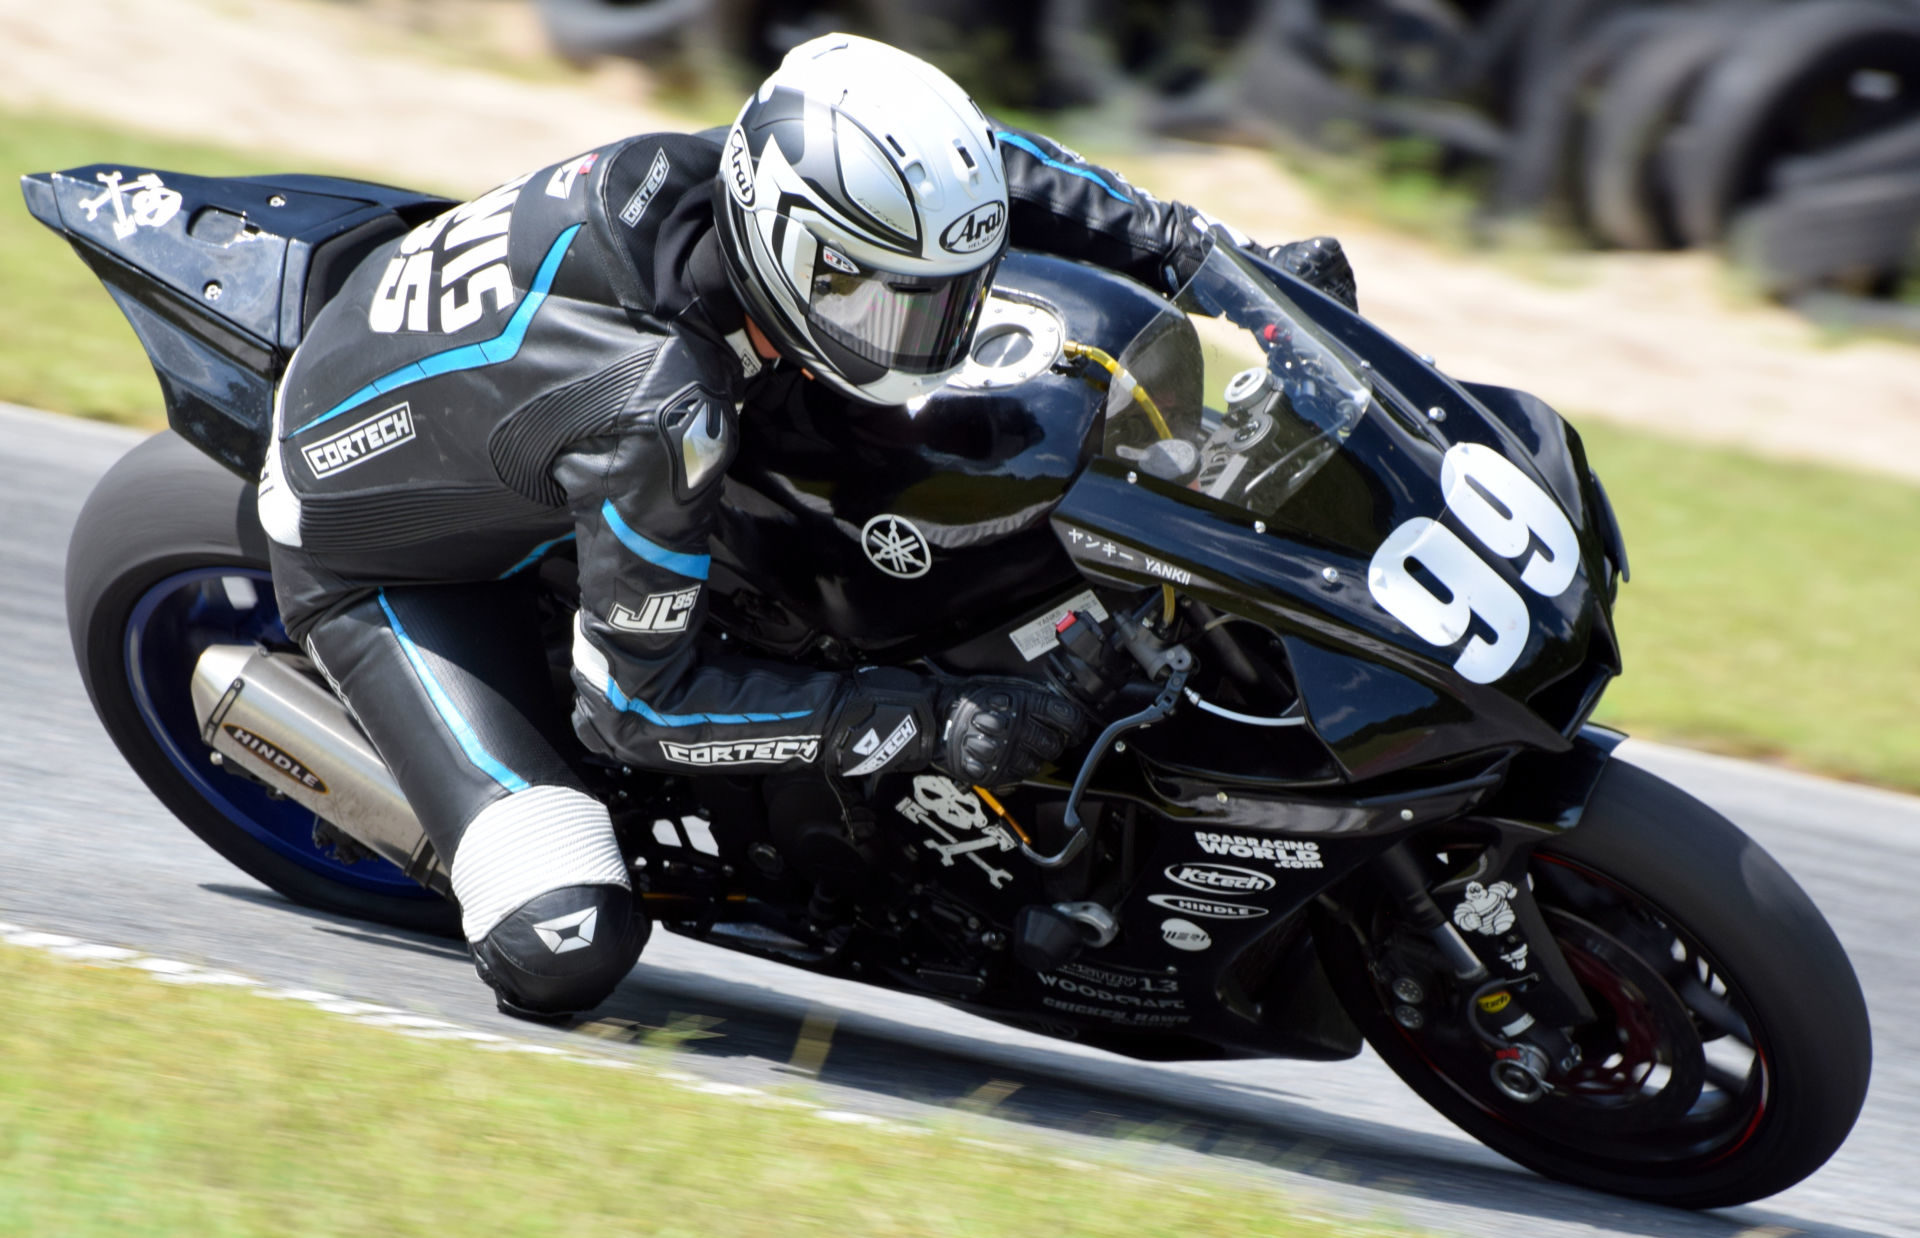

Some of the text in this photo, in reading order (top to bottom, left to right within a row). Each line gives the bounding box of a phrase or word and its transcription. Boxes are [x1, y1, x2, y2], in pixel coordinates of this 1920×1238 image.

[623, 154, 667, 223] CORTECH
[731, 135, 753, 198] Arai
[947, 202, 1001, 249] Arai
[308, 410, 411, 472] CORTECH
[1068, 528, 1192, 585] ヤンキー YANKII
[1368, 442, 1580, 684] 99
[234, 729, 318, 787] HINDLE
[1195, 831, 1319, 851] ROADRACING
[1197, 841, 1321, 861] WORLD
[1274, 860, 1323, 869] .com
[1178, 900, 1249, 915] HINDLE
[1037, 971, 1187, 1009] WOODCRAFT
